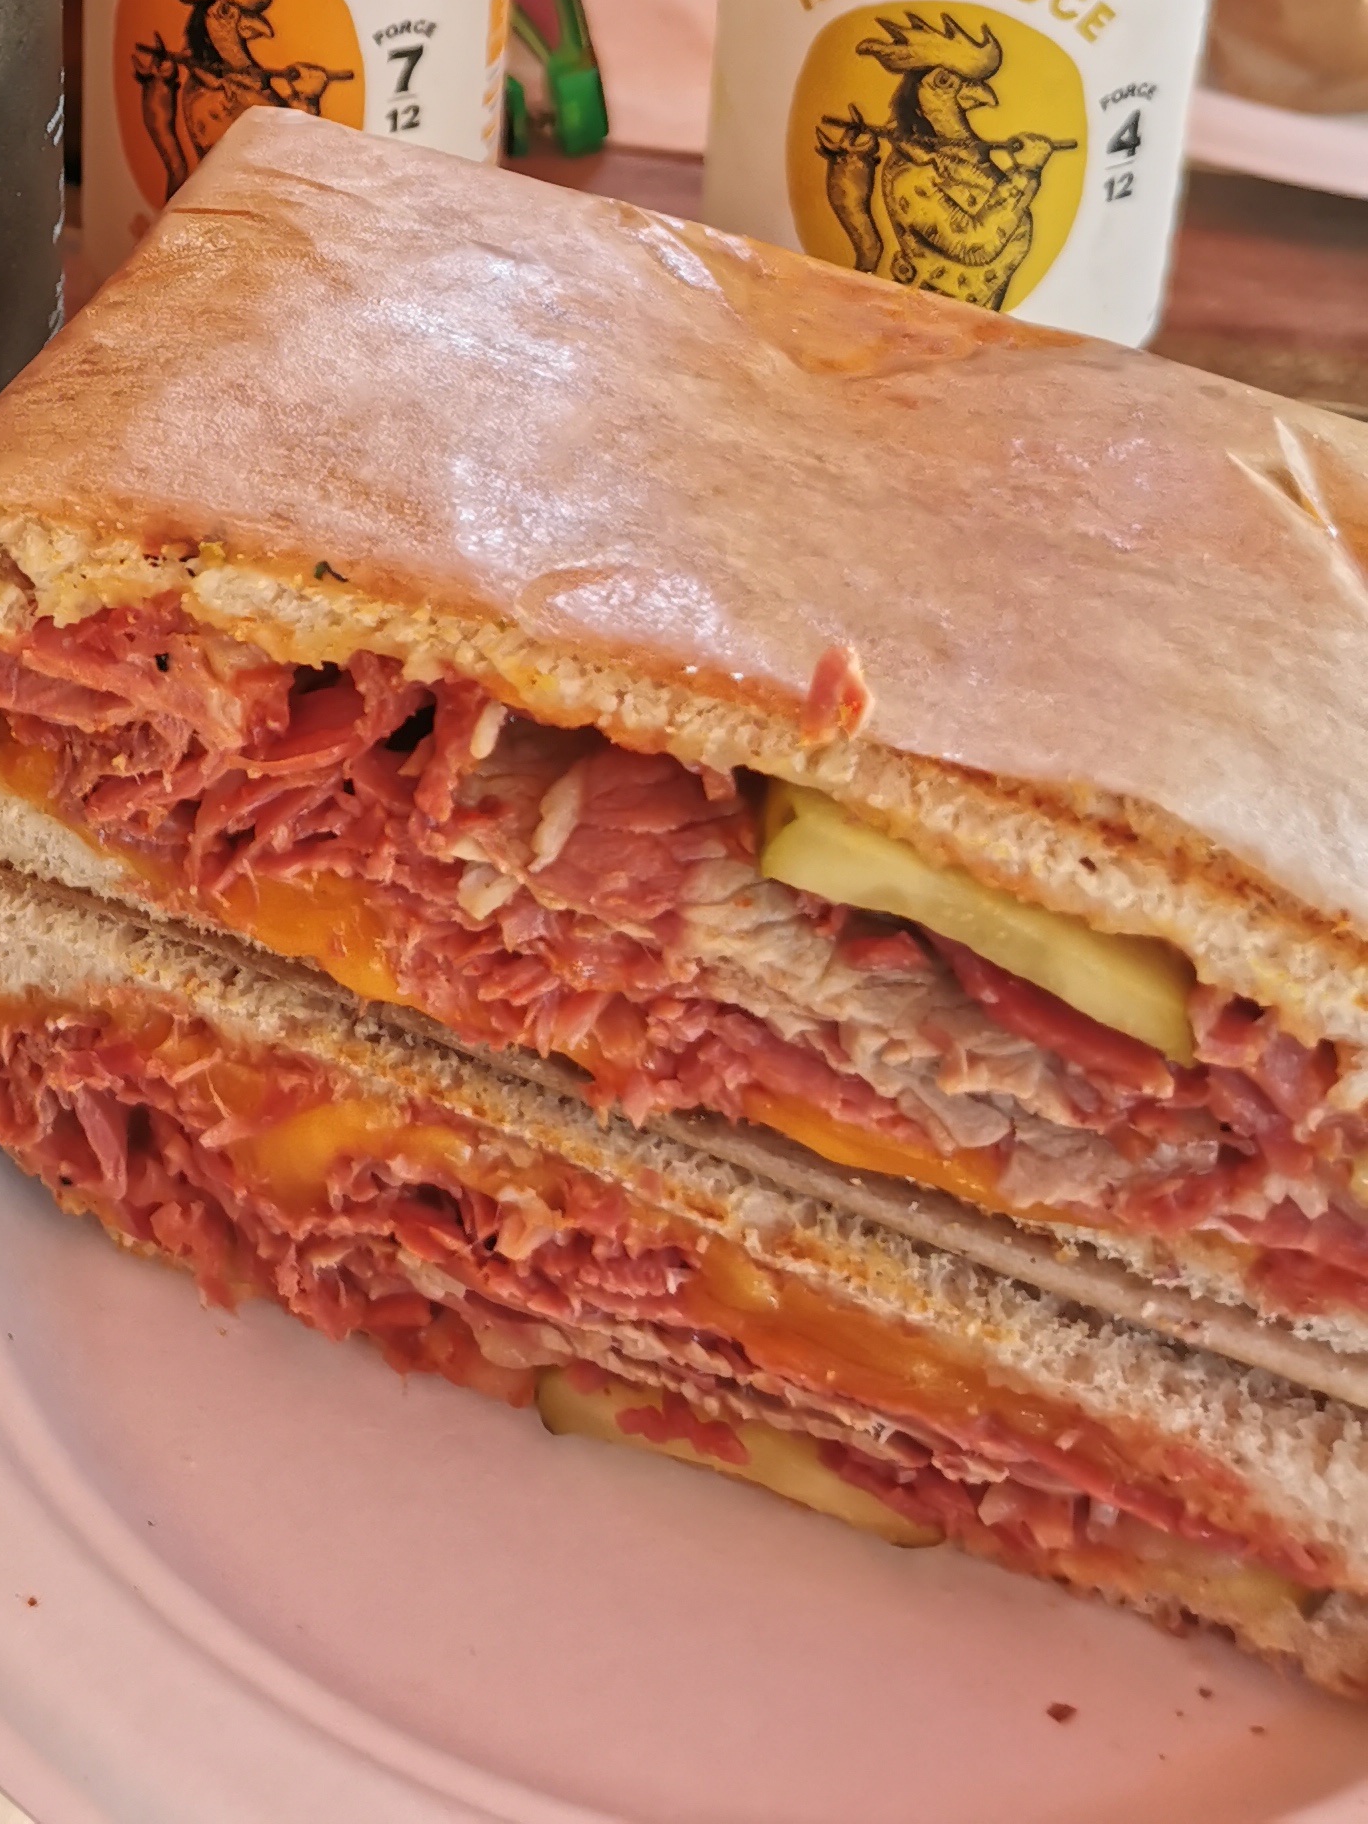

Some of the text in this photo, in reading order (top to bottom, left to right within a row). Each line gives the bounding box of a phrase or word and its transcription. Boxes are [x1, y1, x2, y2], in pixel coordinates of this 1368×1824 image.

[372, 19, 437, 45] FORCE
[387, 44, 423, 95] 7
[1099, 83, 1158, 111] FORCE
[386, 104, 421, 133] 12
[1107, 109, 1142, 161] 4
[1104, 173, 1134, 202] 12
